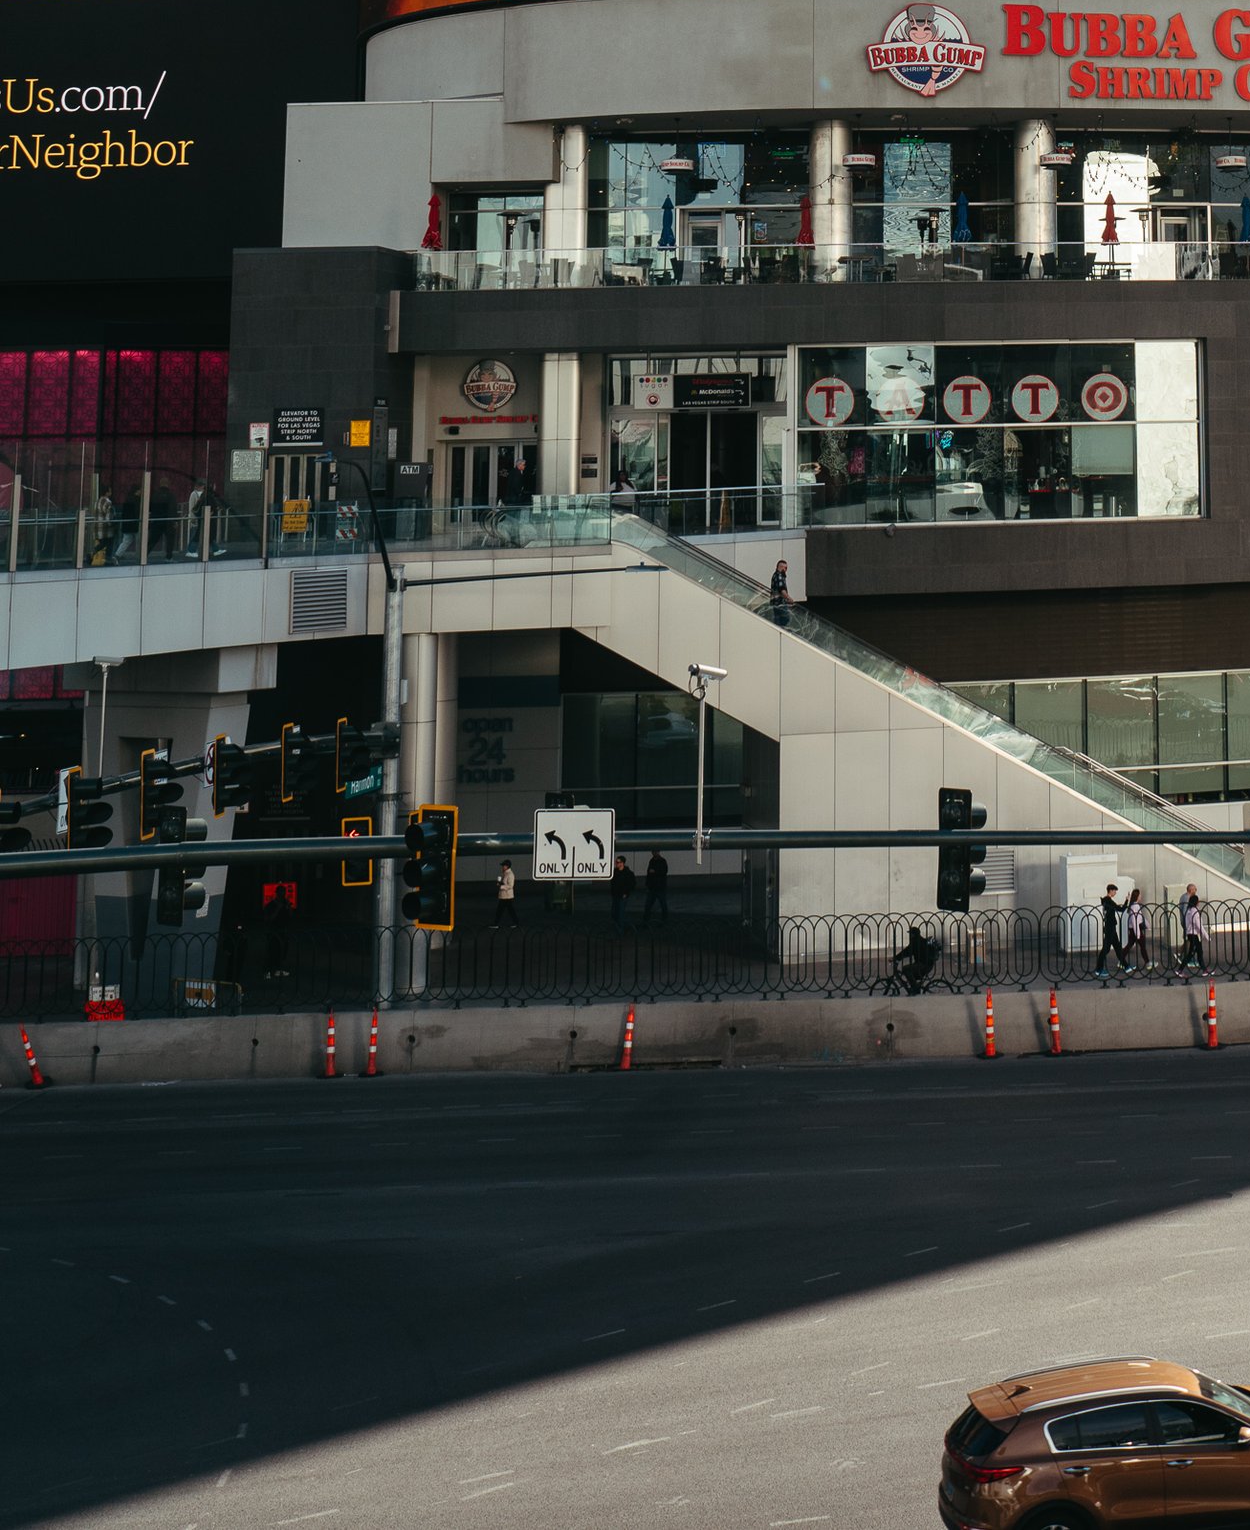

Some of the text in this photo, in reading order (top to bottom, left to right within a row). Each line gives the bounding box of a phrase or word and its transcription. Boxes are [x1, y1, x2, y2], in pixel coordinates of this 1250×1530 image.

[1002, 4, 1198, 59] BUBBA
[870, 43, 983, 67] BUBBA GUMP
[1068, 60, 1223, 101] SHRIMP
[401, 466, 419, 474] ATM
[463, 717, 514, 738] open
[468, 736, 506, 766] 24
[350, 775, 375, 795] Harmon
[459, 765, 516, 784] hours
[539, 862, 607, 874] ONLY ONLY
